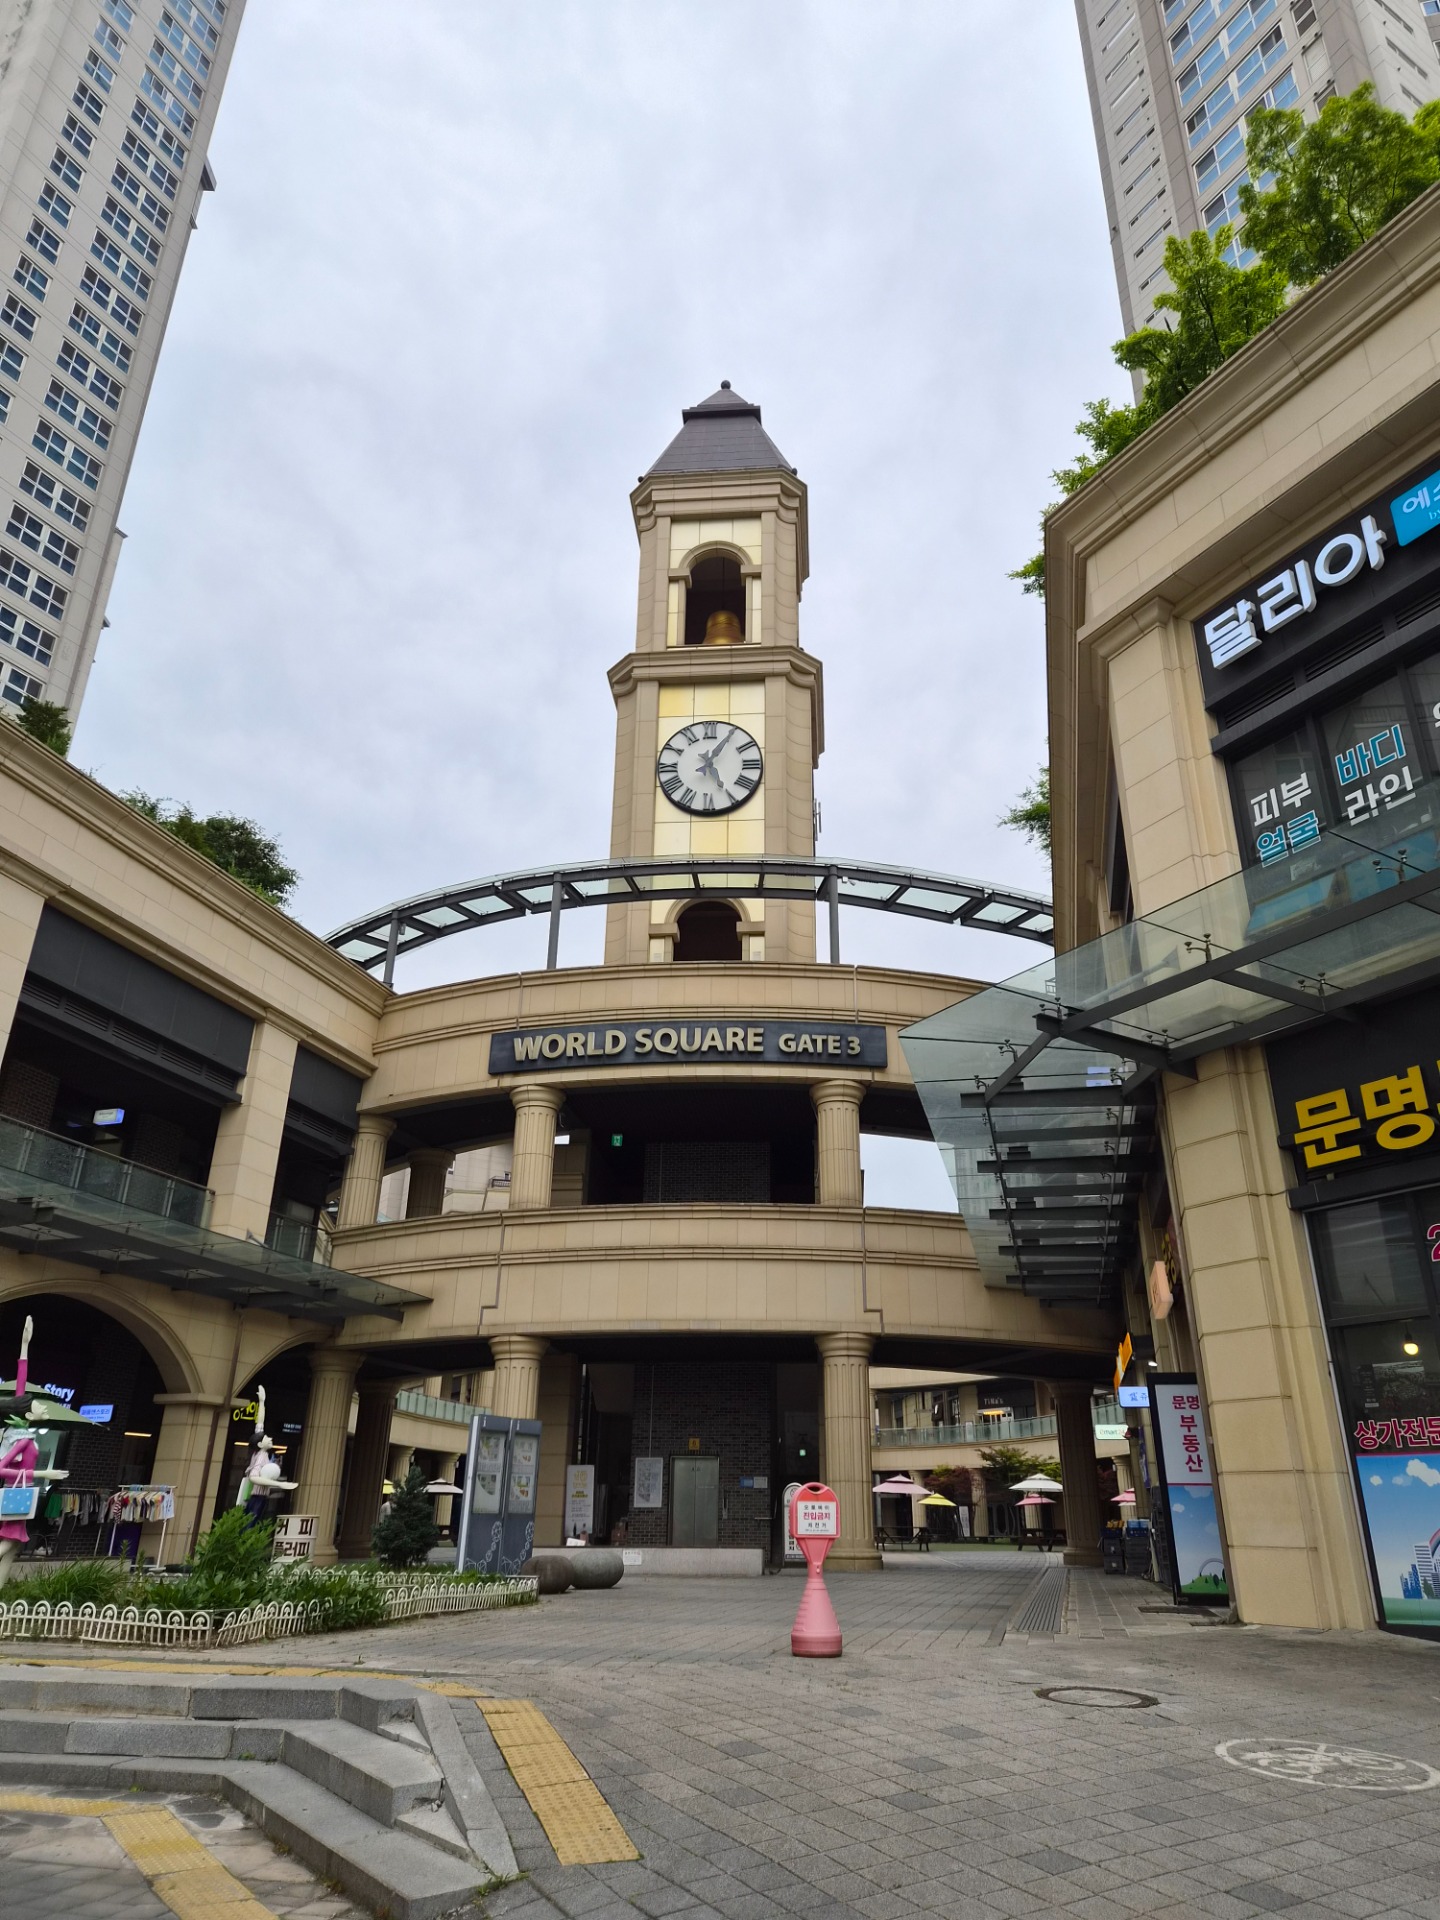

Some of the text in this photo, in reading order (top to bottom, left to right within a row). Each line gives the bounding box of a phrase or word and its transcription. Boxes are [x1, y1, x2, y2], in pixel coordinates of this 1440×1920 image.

[1402, 482, 1440, 513] 에
[1203, 514, 1387, 669] 달리아
[1335, 724, 1406, 786] 바디
[1250, 772, 1312, 827] 피부
[1345, 765, 1416, 826] 라인
[1257, 809, 1321, 868] 얼굴
[513, 1027, 861, 1061] WORLD SQUARE GATE 3
[1294, 1060, 1440, 1168] 문명
[43, 1383, 75, 1402] Story
[1172, 1394, 1200, 1410] 문명
[1180, 1414, 1204, 1473] 부동산
[803, 1512, 831, 1520] 진입금지
